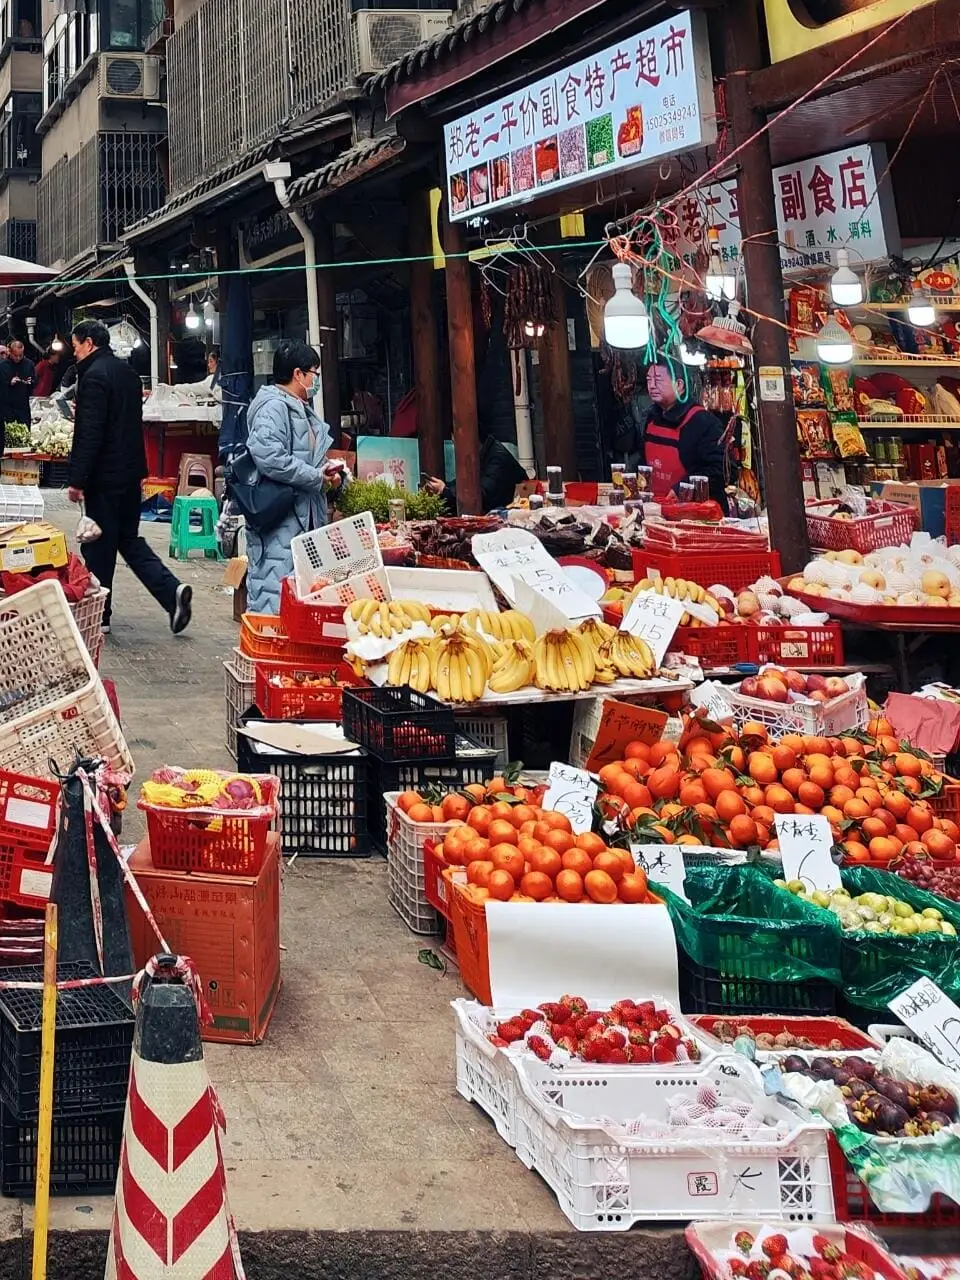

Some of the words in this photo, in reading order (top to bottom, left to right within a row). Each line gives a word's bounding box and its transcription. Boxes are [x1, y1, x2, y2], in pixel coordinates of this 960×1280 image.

[449, 24, 687, 165] 郑老二平价副食特产超市
[662, 94, 675, 108] 电话
[646, 103, 697, 131] 15025349243
